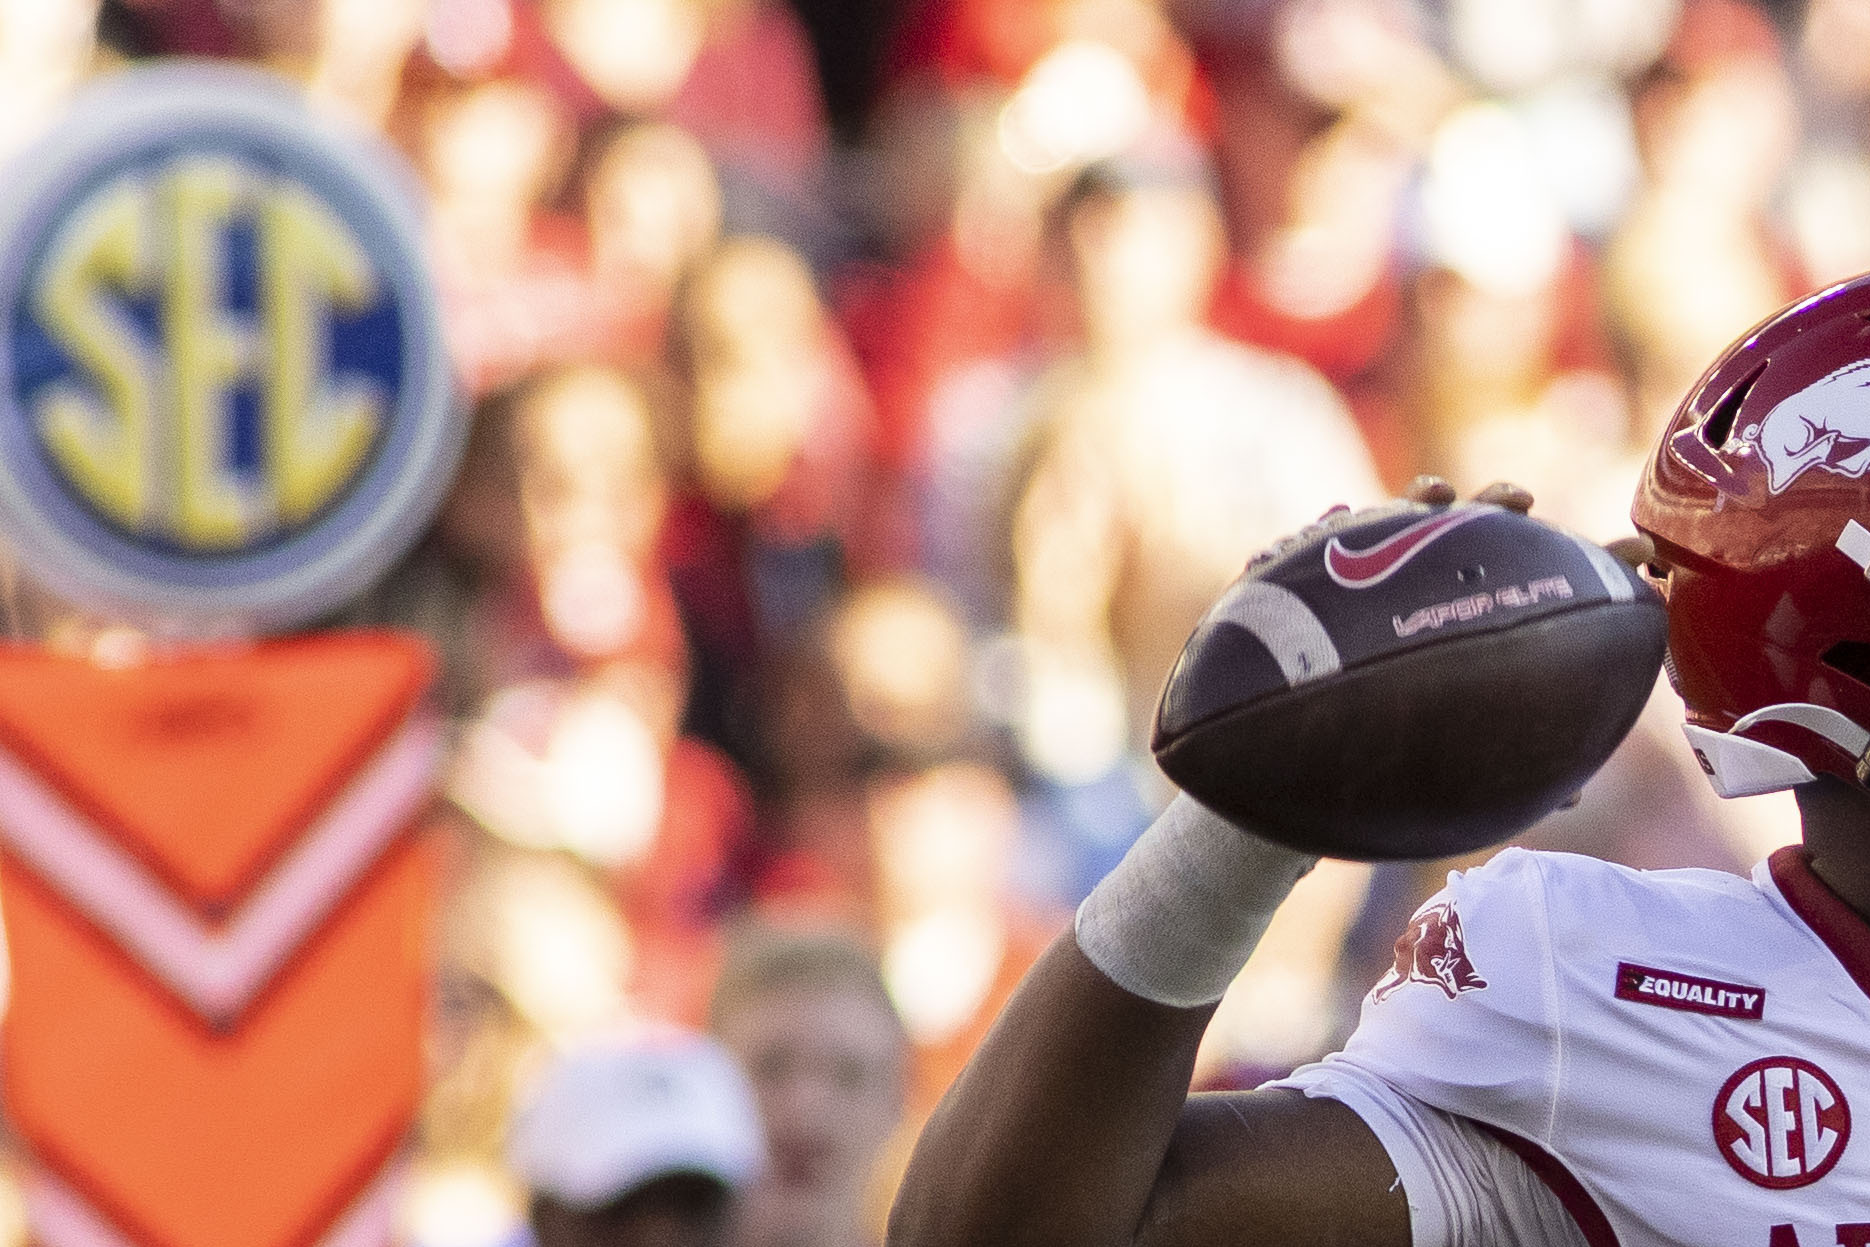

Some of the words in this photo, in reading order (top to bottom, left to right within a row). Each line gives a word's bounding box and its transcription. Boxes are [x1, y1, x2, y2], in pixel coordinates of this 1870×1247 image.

[32, 156, 382, 548] SEC
[1638, 975, 1759, 1011] EQUALITY
[1725, 1066, 1839, 1178] SEC
